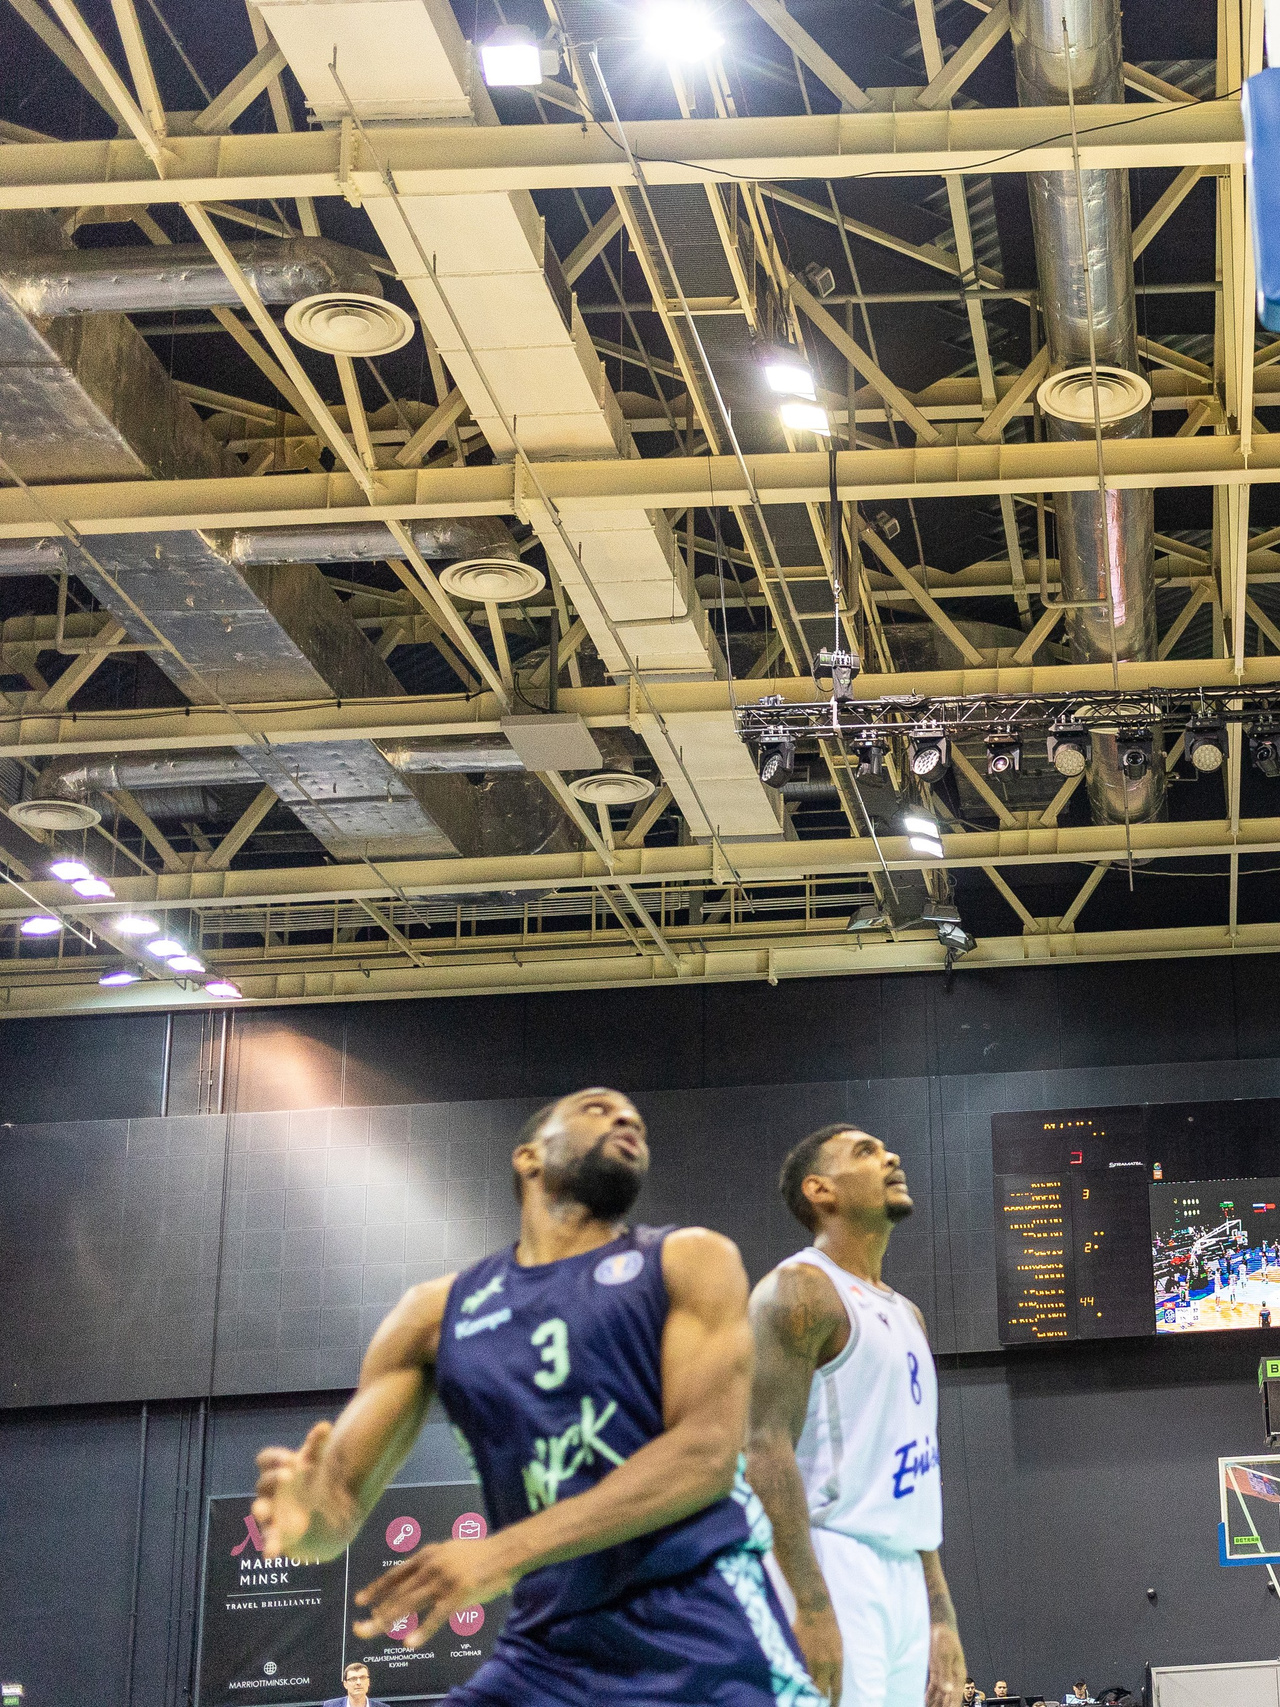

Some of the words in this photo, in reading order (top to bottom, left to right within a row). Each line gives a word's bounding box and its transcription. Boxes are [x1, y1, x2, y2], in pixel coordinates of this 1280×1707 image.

[531, 1317, 570, 1390] 3
[907, 1351, 922, 1405] 8
[240, 1573, 288, 1586] MINSK
[226, 1602, 258, 1610] TRAVEL
[261, 1598, 321, 1608] BRILLIANTLY
[456, 1611, 478, 1623] VIP
[363, 1652, 435, 1663] СРЕДИЗЕМНОМОРСКОЙ
[229, 1678, 310, 1689] MARRIOTTMINSK.COM
